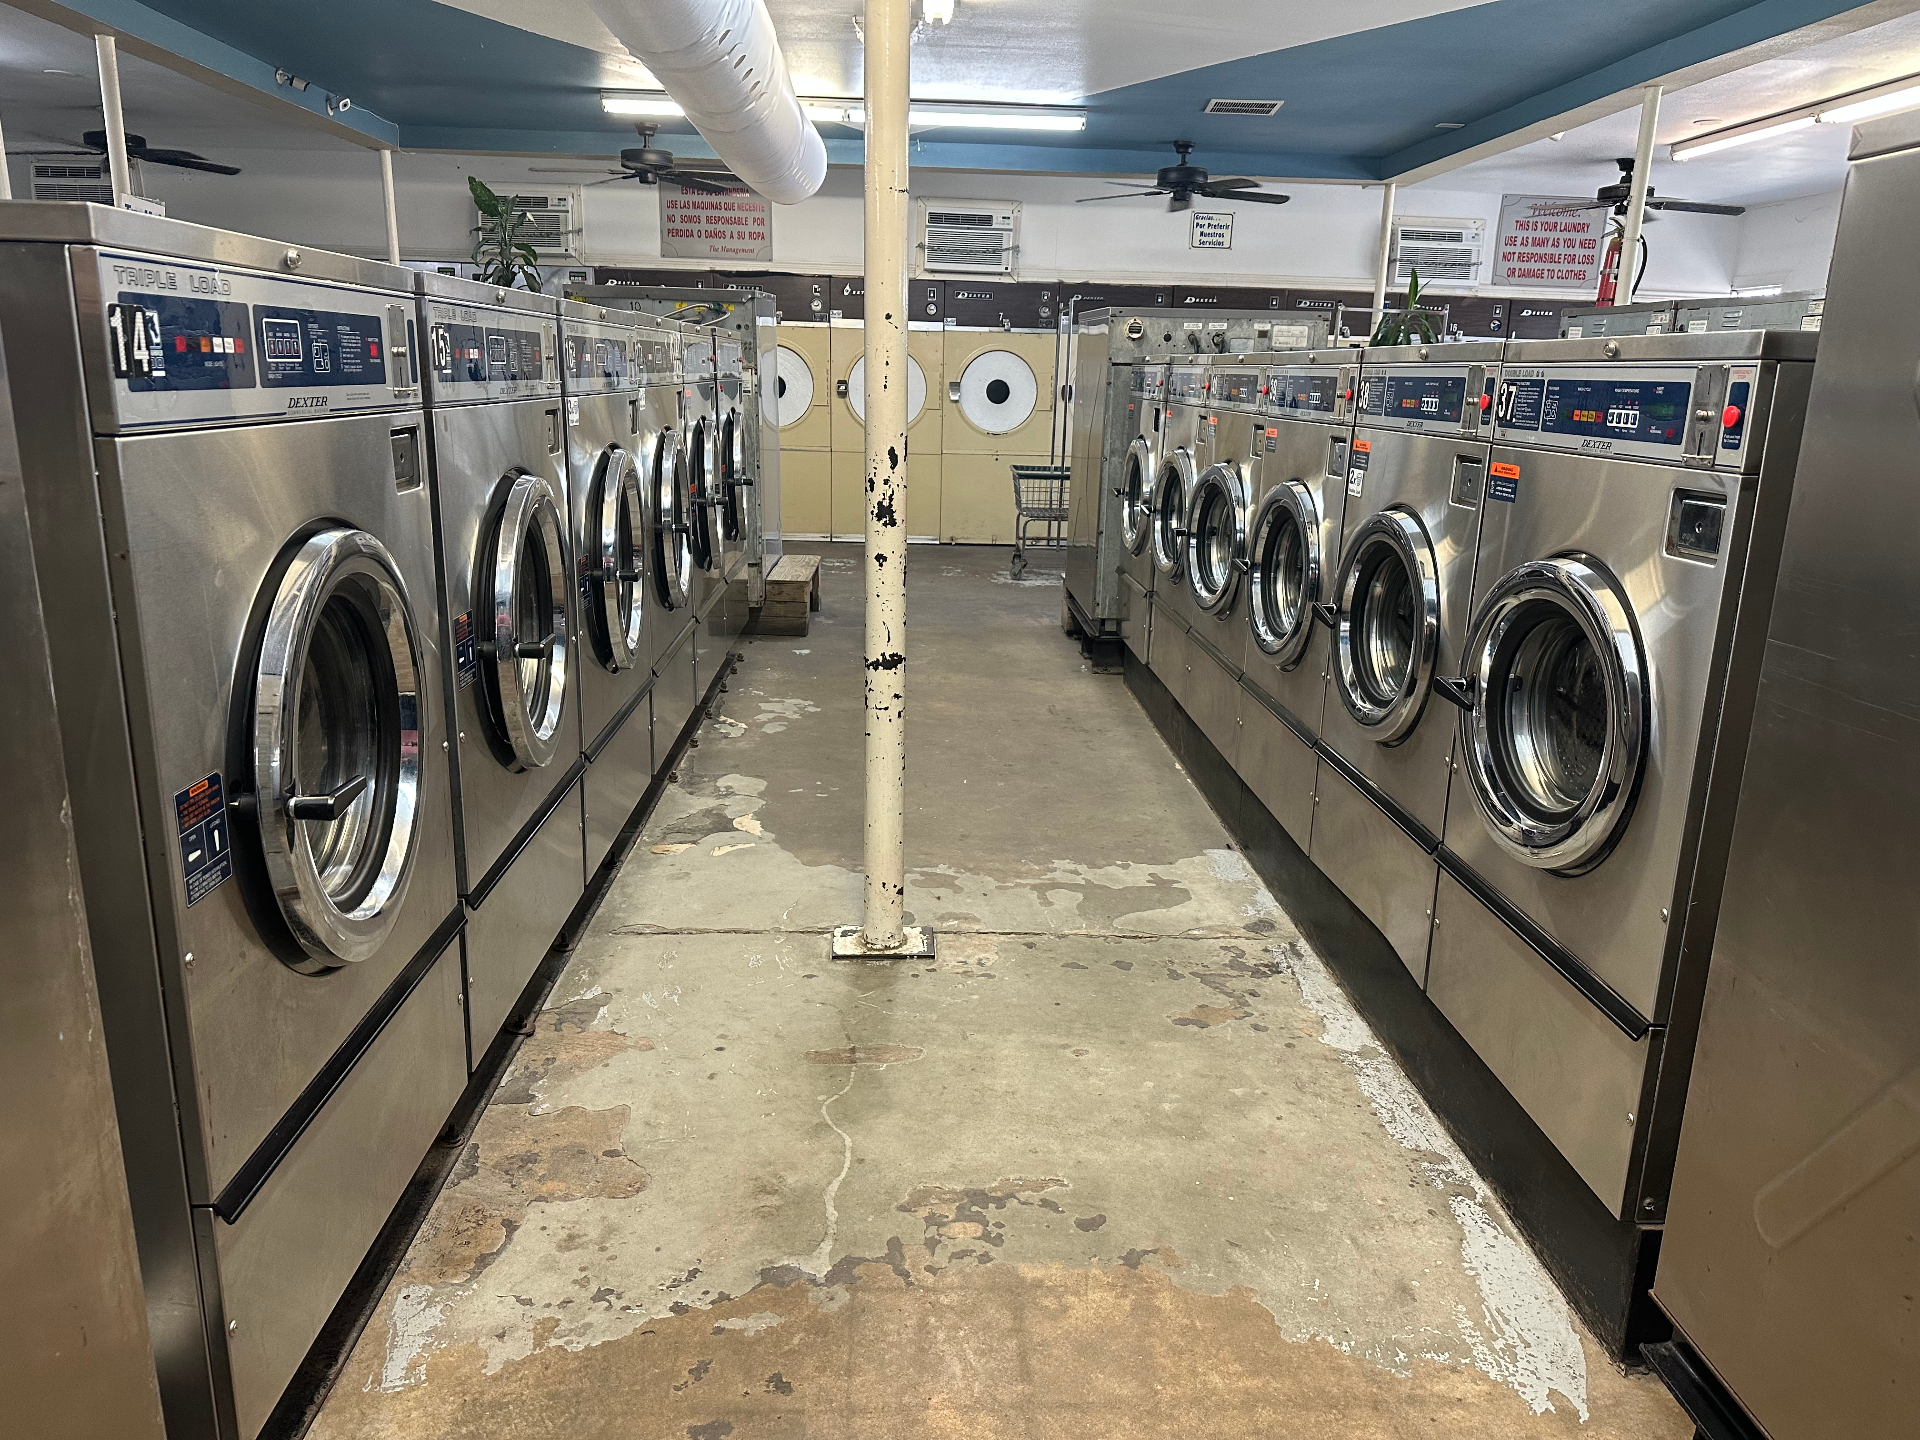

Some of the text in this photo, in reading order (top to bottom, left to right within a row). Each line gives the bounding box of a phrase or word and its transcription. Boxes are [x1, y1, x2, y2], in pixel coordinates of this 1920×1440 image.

[666, 200, 765, 212] USE LAS MAQUINAS QUE NECESITE
[667, 214, 765, 226] NO SOMOS RESPONSABLE POR
[1208, 222, 1230, 230] Preferir
[1515, 220, 1590, 233] THIS IS YOUR LAUNDRY
[667, 227, 765, 240] PÉRDIDA O DAÑOS A SU ROPA
[1504, 236, 1596, 249] USE AS MANY AS YOU NEED
[720, 246, 754, 254] Management
[1502, 252, 1594, 265] NOT RESPONSIBLE FOR LOSS
[113, 265, 231, 295] TRIPLE LOAD
[1506, 267, 1586, 280] OR DAMAGE TO CLOTHES
[433, 306, 457, 320] TRIPLE
[629, 301, 642, 312] 10
[1449, 323, 1458, 332] 16
[110, 306, 149, 372] 14
[431, 327, 446, 367] 15
[1358, 380, 1370, 410] 38
[1498, 382, 1517, 420] 37
[287, 396, 328, 409] DEXTER
[1582, 439, 1612, 450] DEXTER
